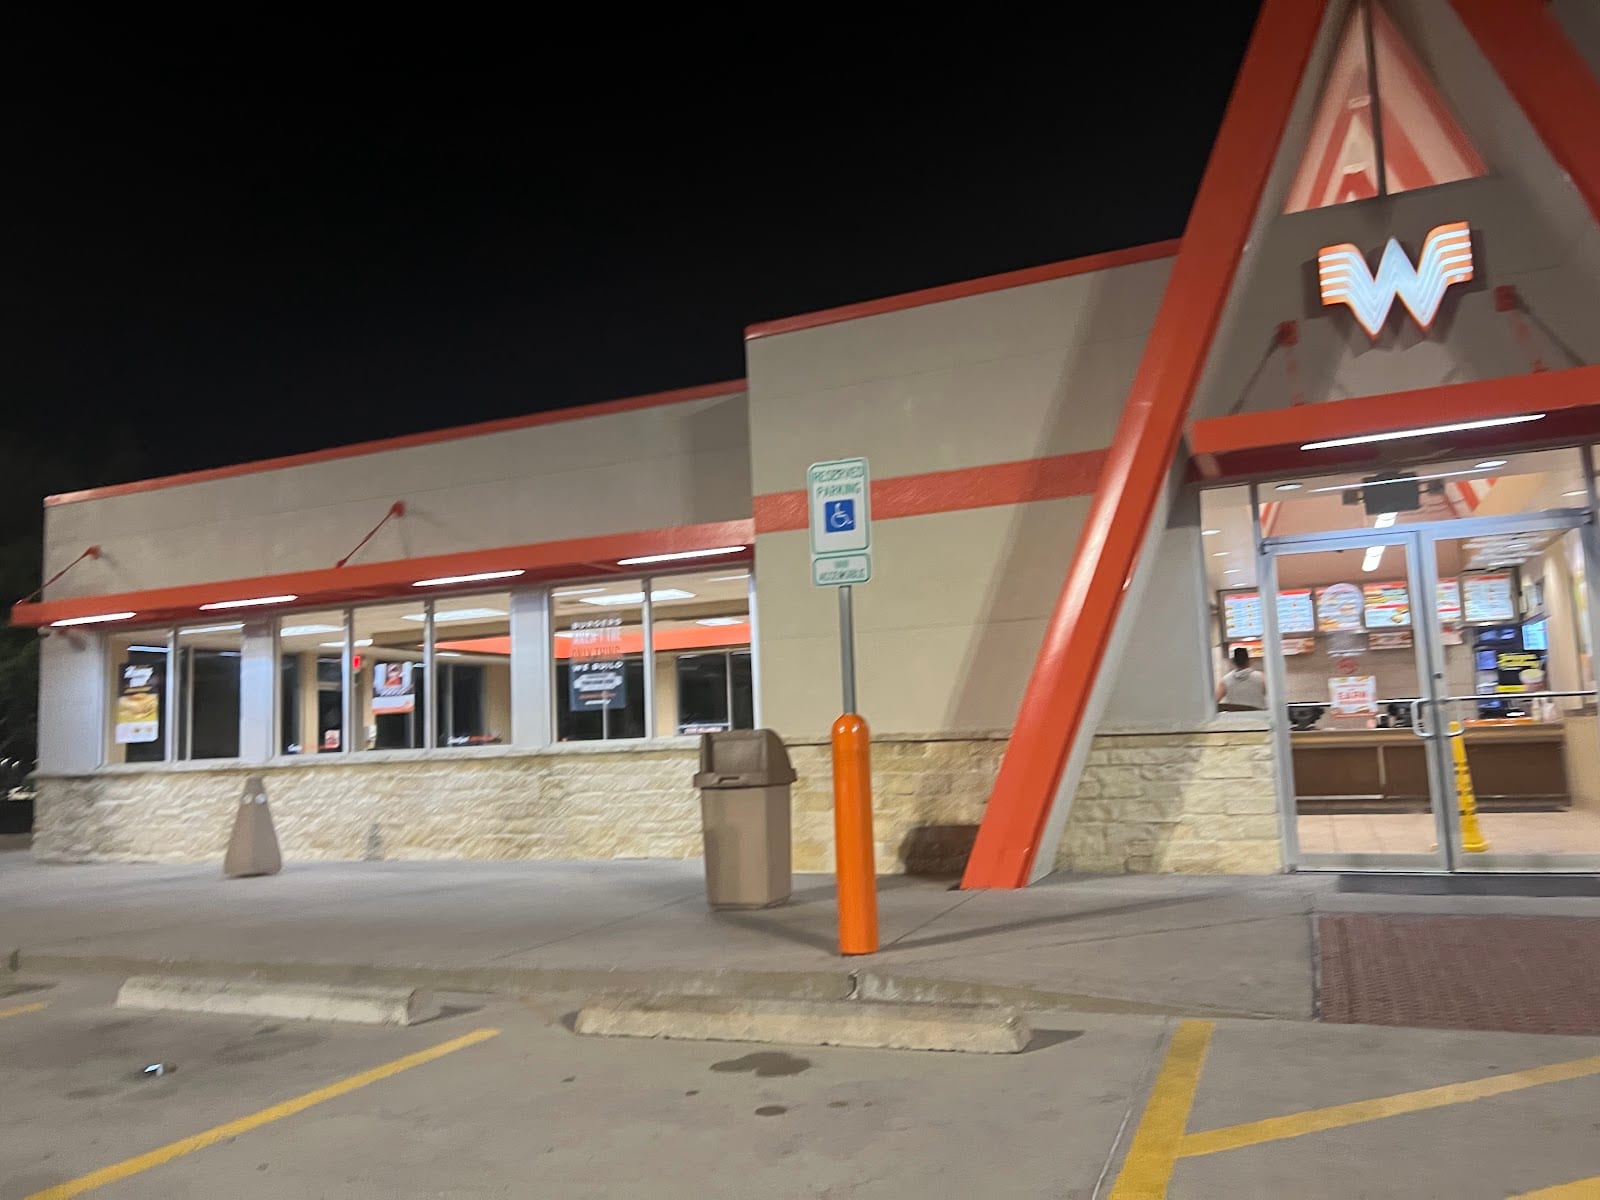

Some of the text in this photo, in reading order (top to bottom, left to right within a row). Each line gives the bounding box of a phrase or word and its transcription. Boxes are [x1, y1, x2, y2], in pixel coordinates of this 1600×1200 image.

[1318, 221, 1474, 339] W
[812, 466, 865, 481] RESERVED
[816, 482, 861, 497] PARKING
[571, 618, 623, 630] BURGERS
[591, 661, 624, 671] BUILD
